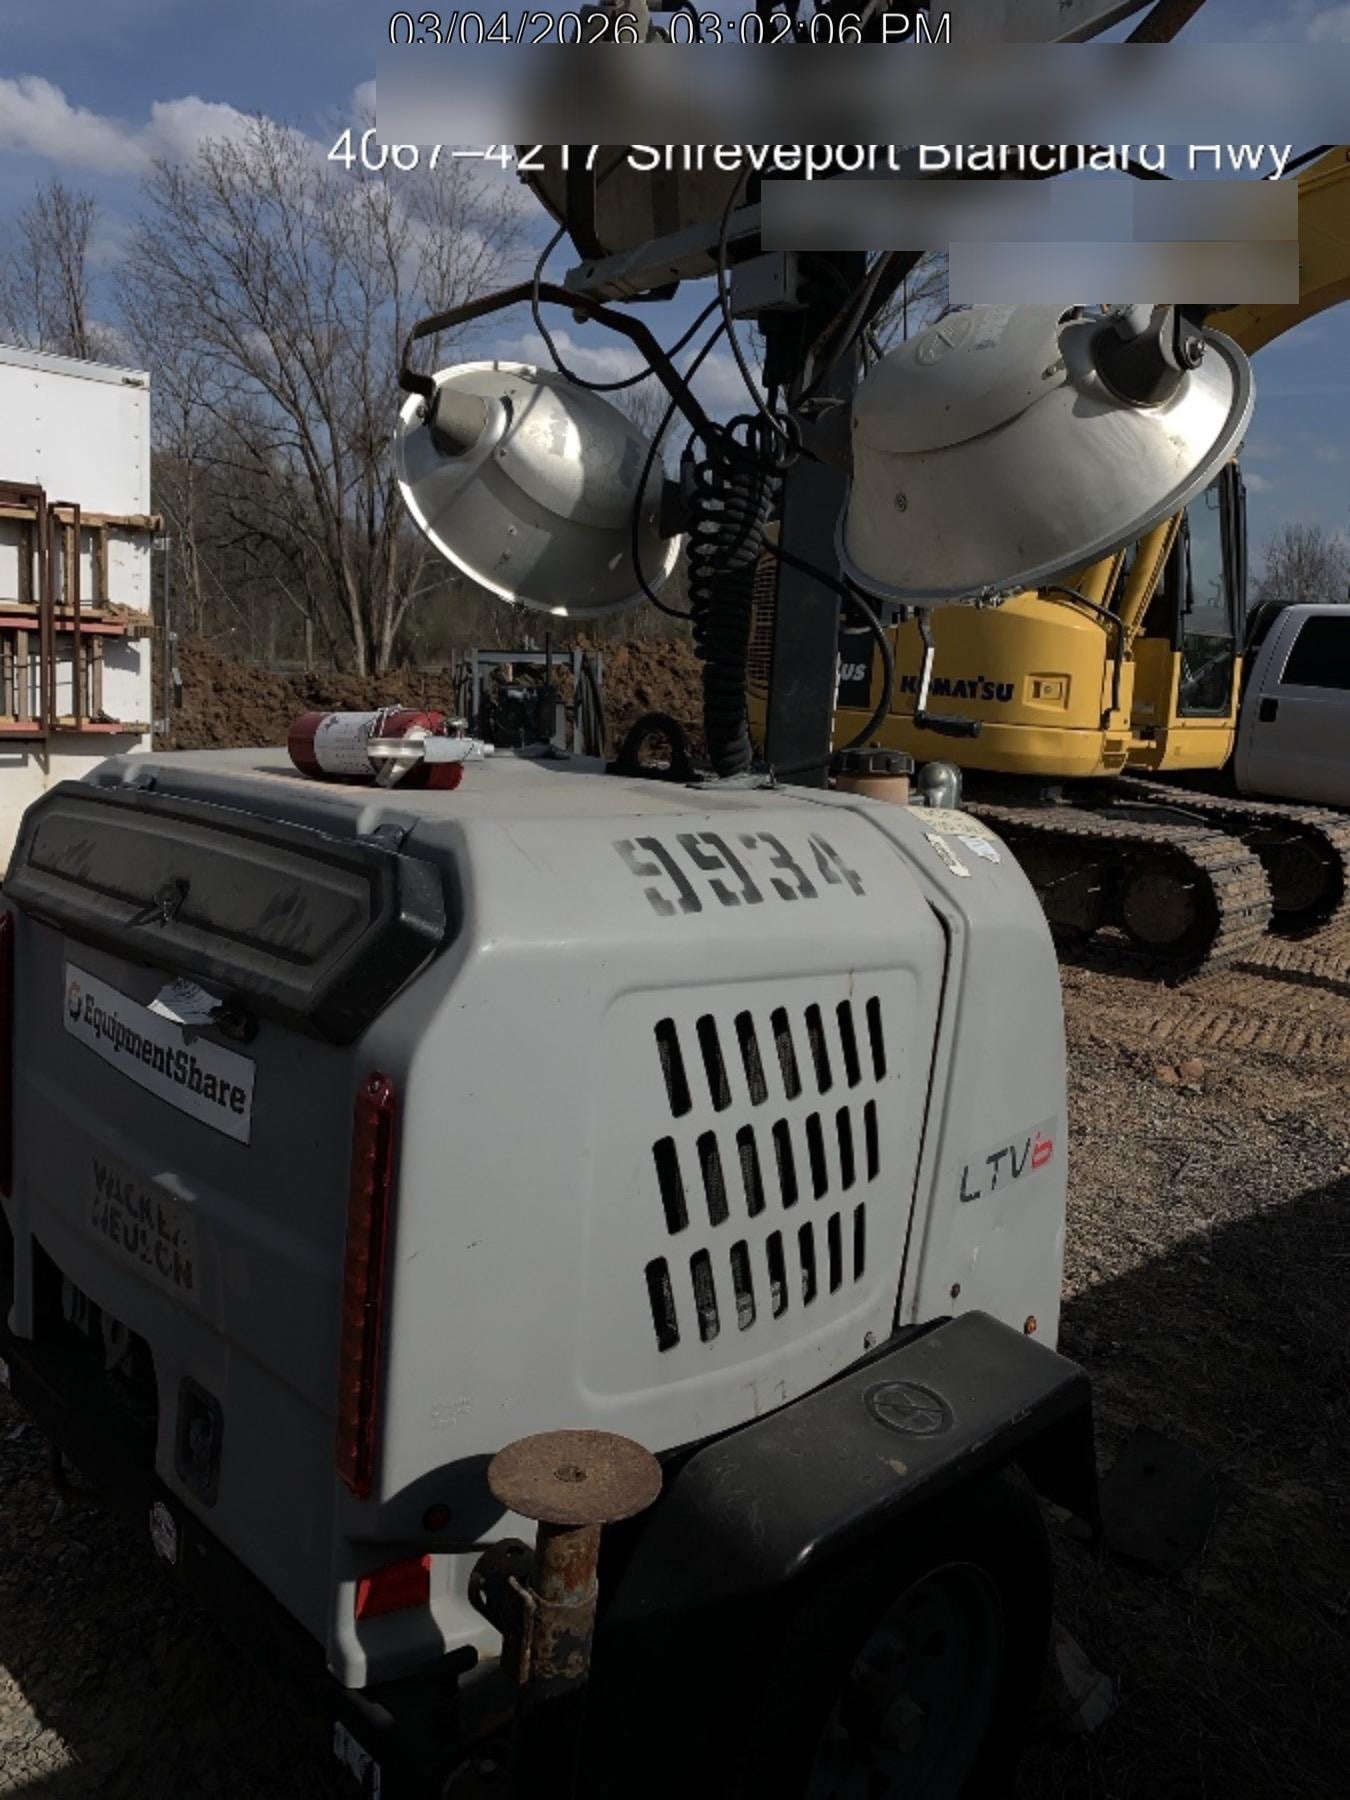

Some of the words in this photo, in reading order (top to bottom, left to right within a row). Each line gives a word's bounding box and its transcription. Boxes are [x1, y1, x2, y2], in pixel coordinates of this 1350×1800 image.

[611, 832, 867, 916] 9934
[84, 994, 247, 1115] EquipmentShare
[960, 1131, 1053, 1202] LTV6
